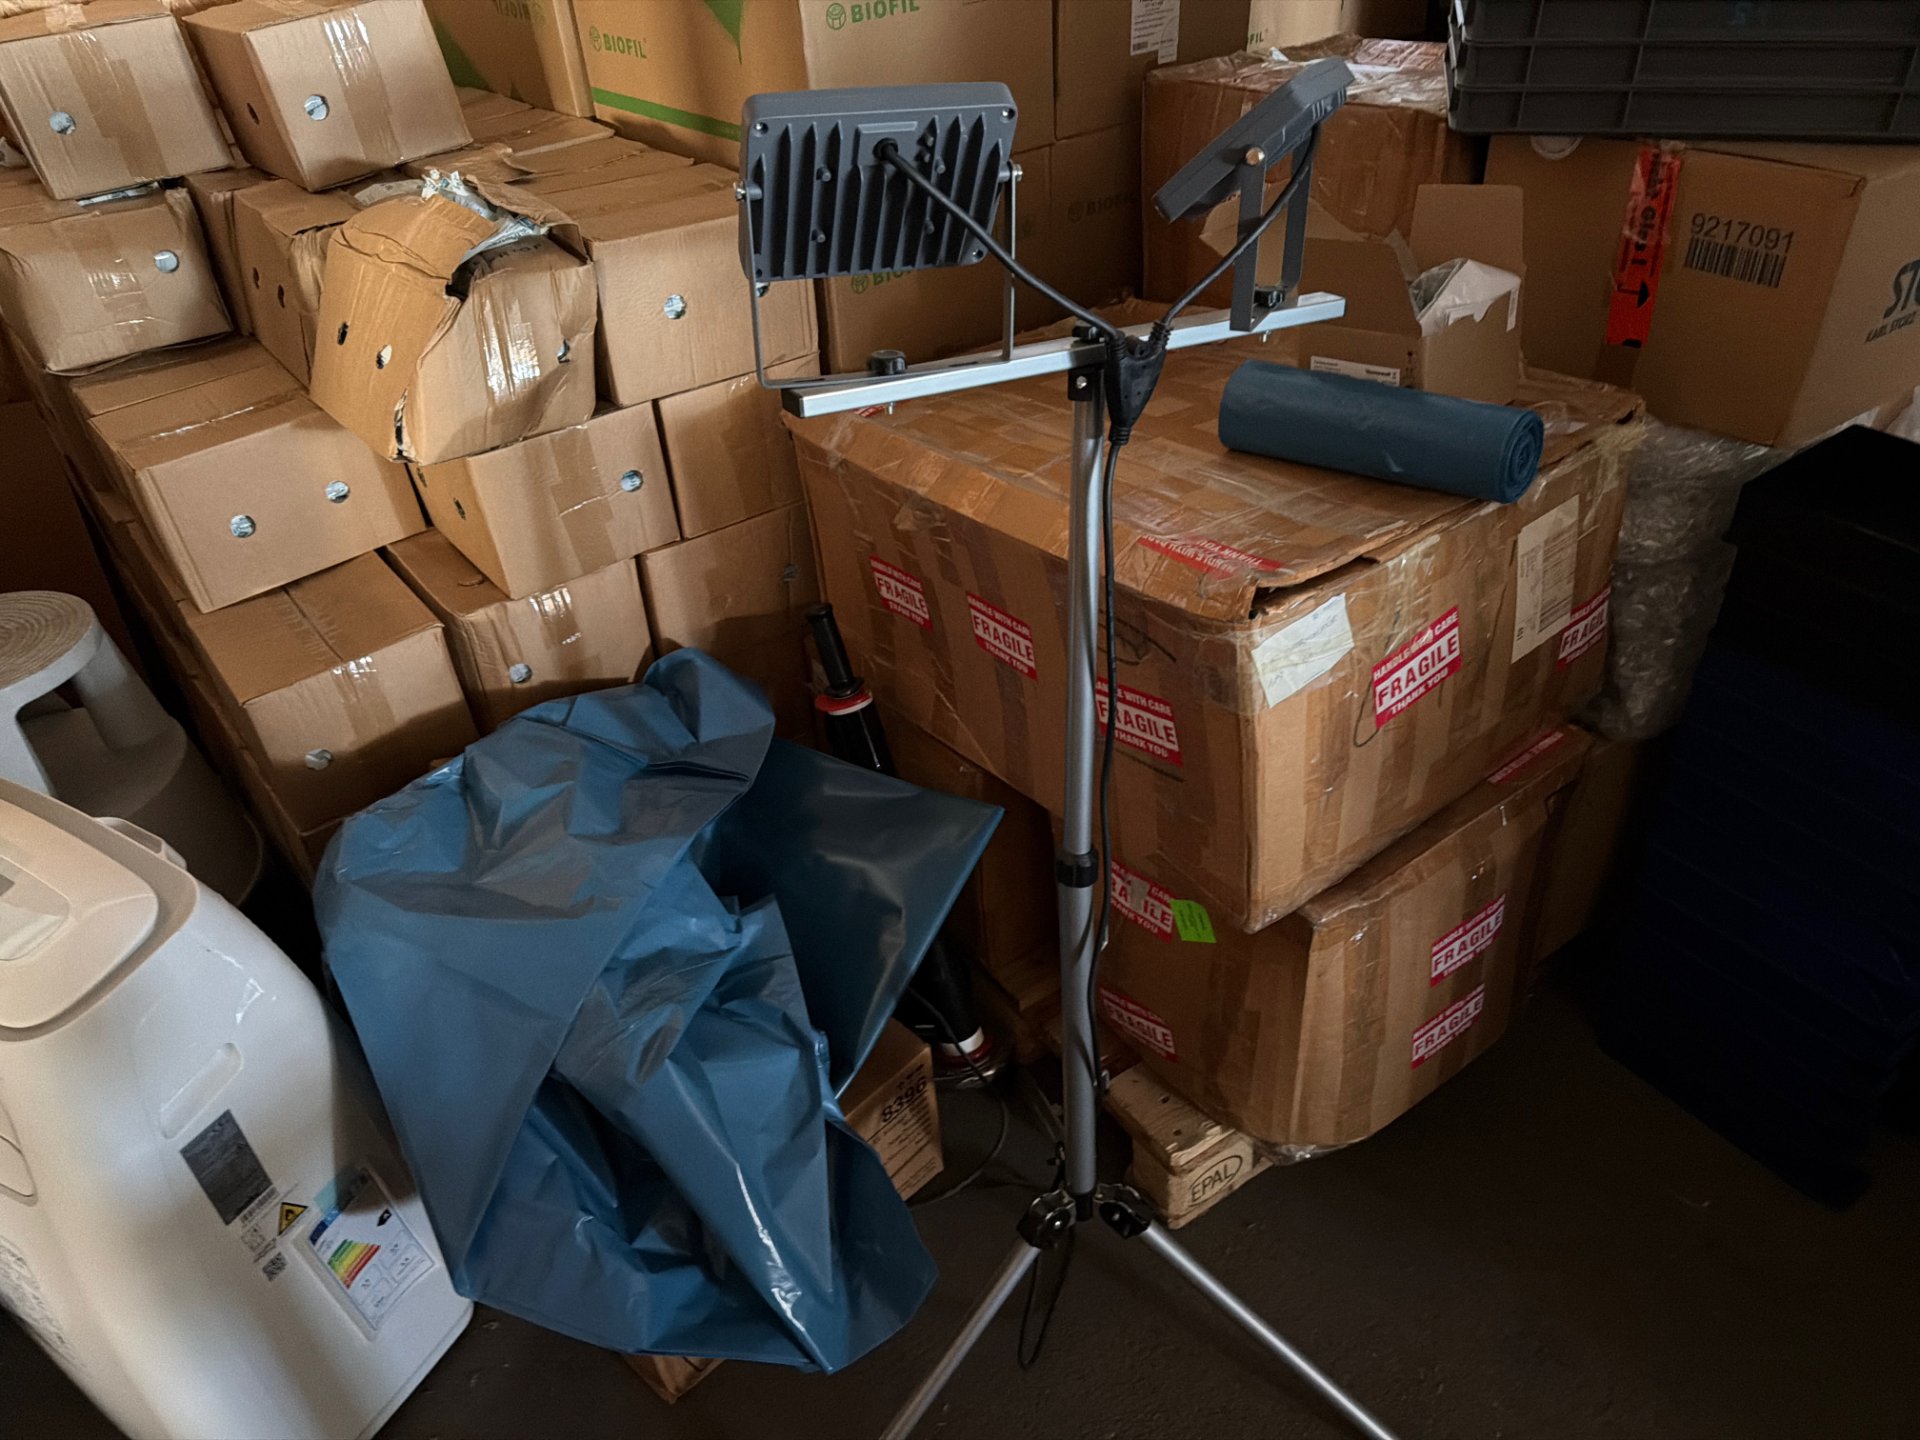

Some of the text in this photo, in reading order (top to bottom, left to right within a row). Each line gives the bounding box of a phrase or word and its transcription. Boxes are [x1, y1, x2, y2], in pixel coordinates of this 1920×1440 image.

[851, 0, 920, 23] BIOFIL
[602, 33, 647, 59] BIOFIL
[1690, 213, 1795, 254] 9217091
[1883, 259, 1920, 319] ST
[876, 577, 929, 615] FRAGILE
[973, 615, 1034, 662] FRAGILE
[1375, 611, 1458, 680] HANDLE CARE
[1379, 634, 1458, 707] FRAGILE
[1391, 667, 1448, 714] THANK YOU
[1124, 691, 1147, 707] WITH
[1147, 699, 1173, 717] CARE
[1147, 742, 1169, 758] YOU
[1137, 916, 1159, 933] YOU
[1434, 910, 1503, 972] FRAGILE
[1105, 1003, 1172, 1048] FRAGILE
[1415, 998, 1482, 1056] FRAGILE
[1191, 1164, 1235, 1203] EPAL
